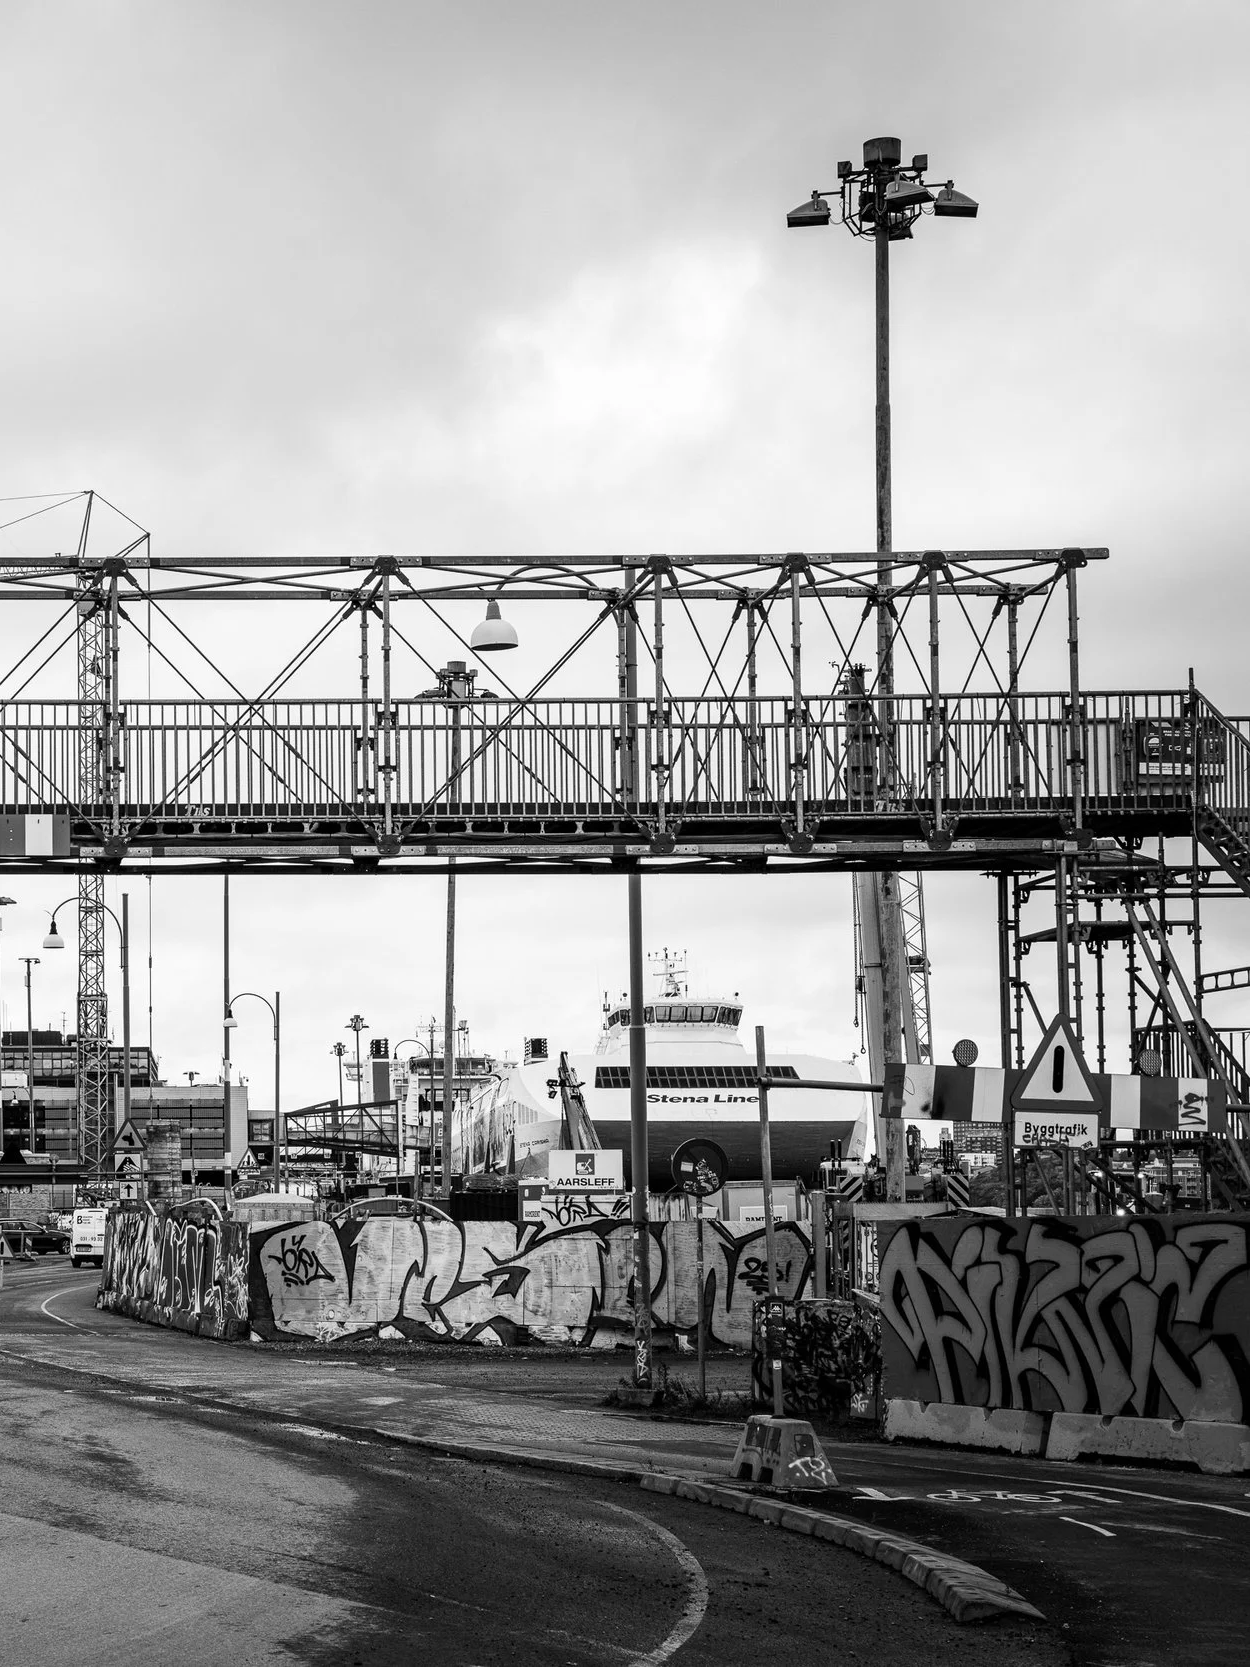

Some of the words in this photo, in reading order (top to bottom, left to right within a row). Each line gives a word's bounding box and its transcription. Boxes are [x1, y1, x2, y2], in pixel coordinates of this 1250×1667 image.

[647, 1094, 709, 1103] Stena
[713, 1094, 760, 1103] Line
[1024, 1122, 1088, 1138] Byggtrafik
[557, 1178, 615, 1186] AARSLEFF
